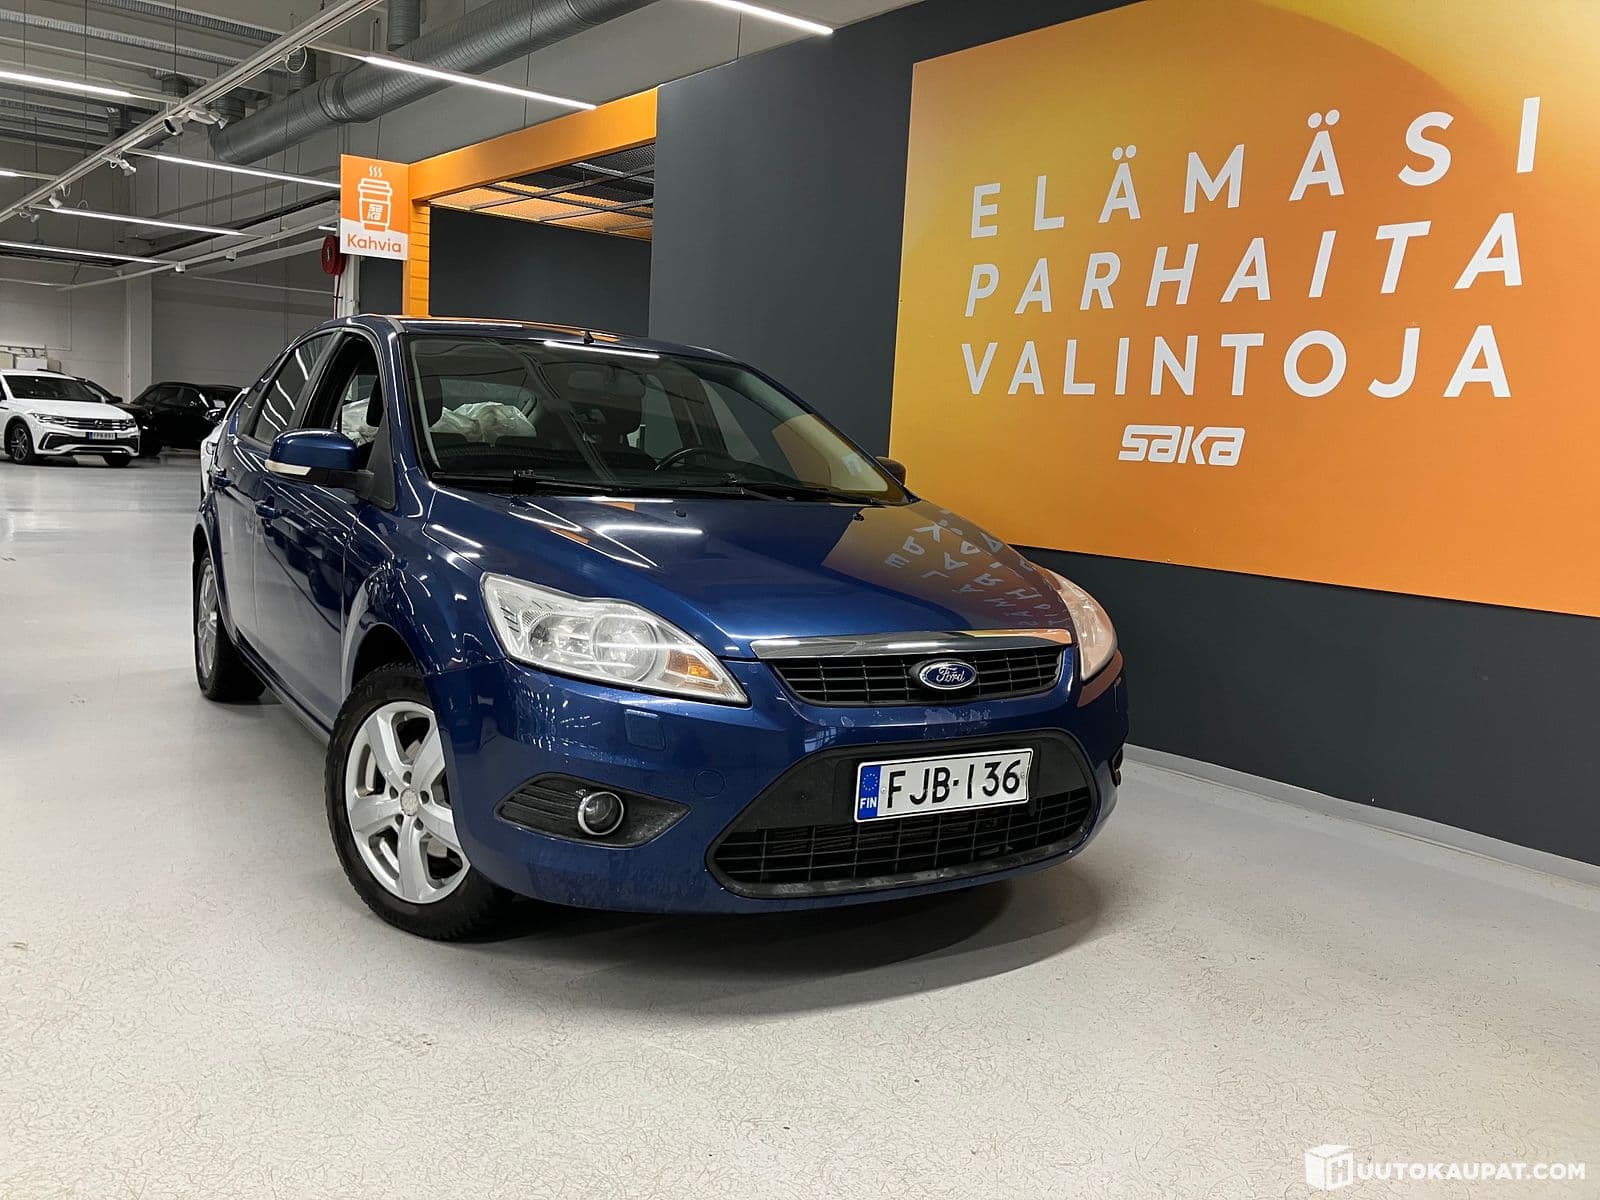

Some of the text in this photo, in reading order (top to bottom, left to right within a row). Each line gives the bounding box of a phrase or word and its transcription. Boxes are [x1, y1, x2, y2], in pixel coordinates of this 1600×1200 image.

[971, 96, 1541, 238] ELÄMÄSI
[347, 233, 402, 253] Kahvia
[965, 212, 1523, 317] PARHAITA
[961, 324, 1512, 399] VALINTOJA
[935, 665, 966, 683] Ford
[859, 796, 878, 810] FIN
[886, 759, 1022, 809] FJB-136
